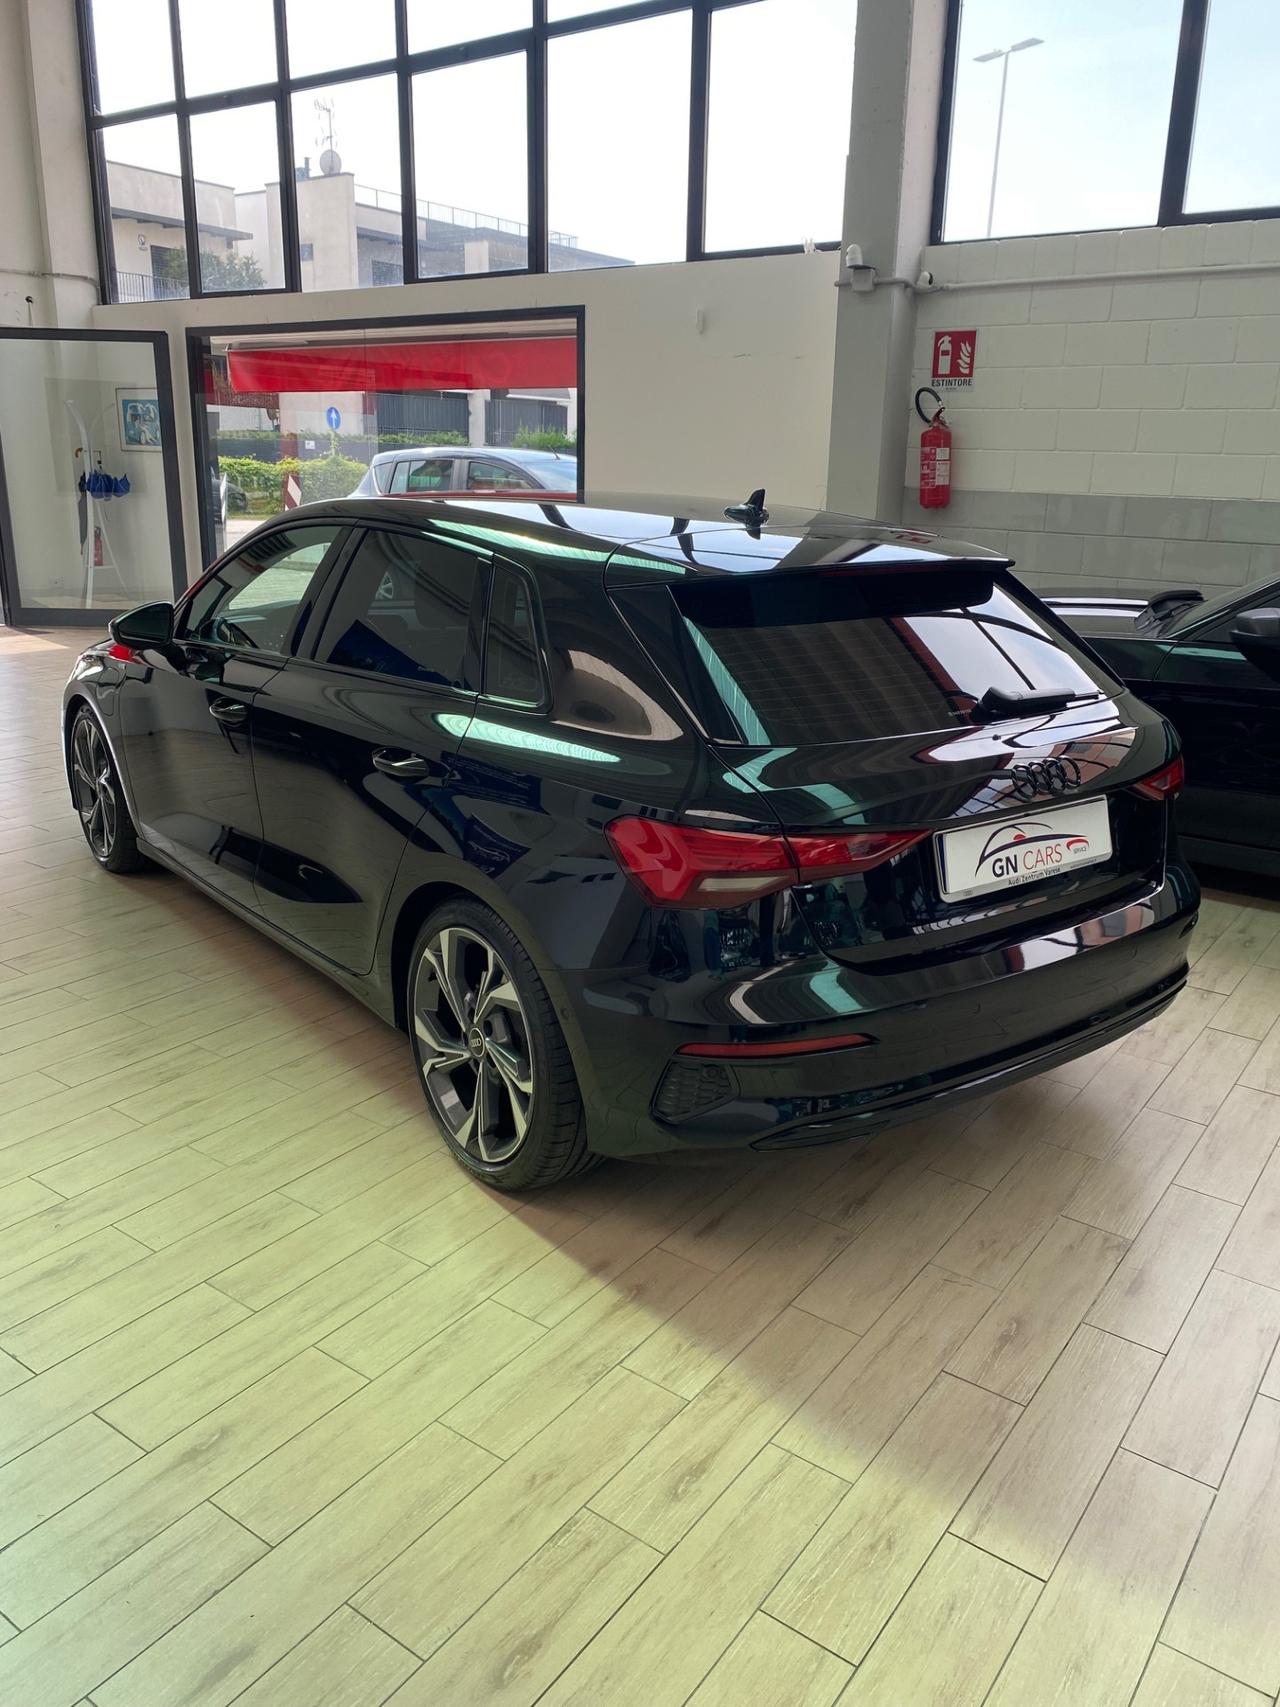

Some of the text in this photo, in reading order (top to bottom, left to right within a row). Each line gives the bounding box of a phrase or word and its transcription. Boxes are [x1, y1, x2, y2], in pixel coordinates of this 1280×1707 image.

[932, 379, 973, 387] ESTINTORE
[992, 843, 1063, 878] GN CARS
[1008, 867, 1061, 886] Audi Zentrum Varese
